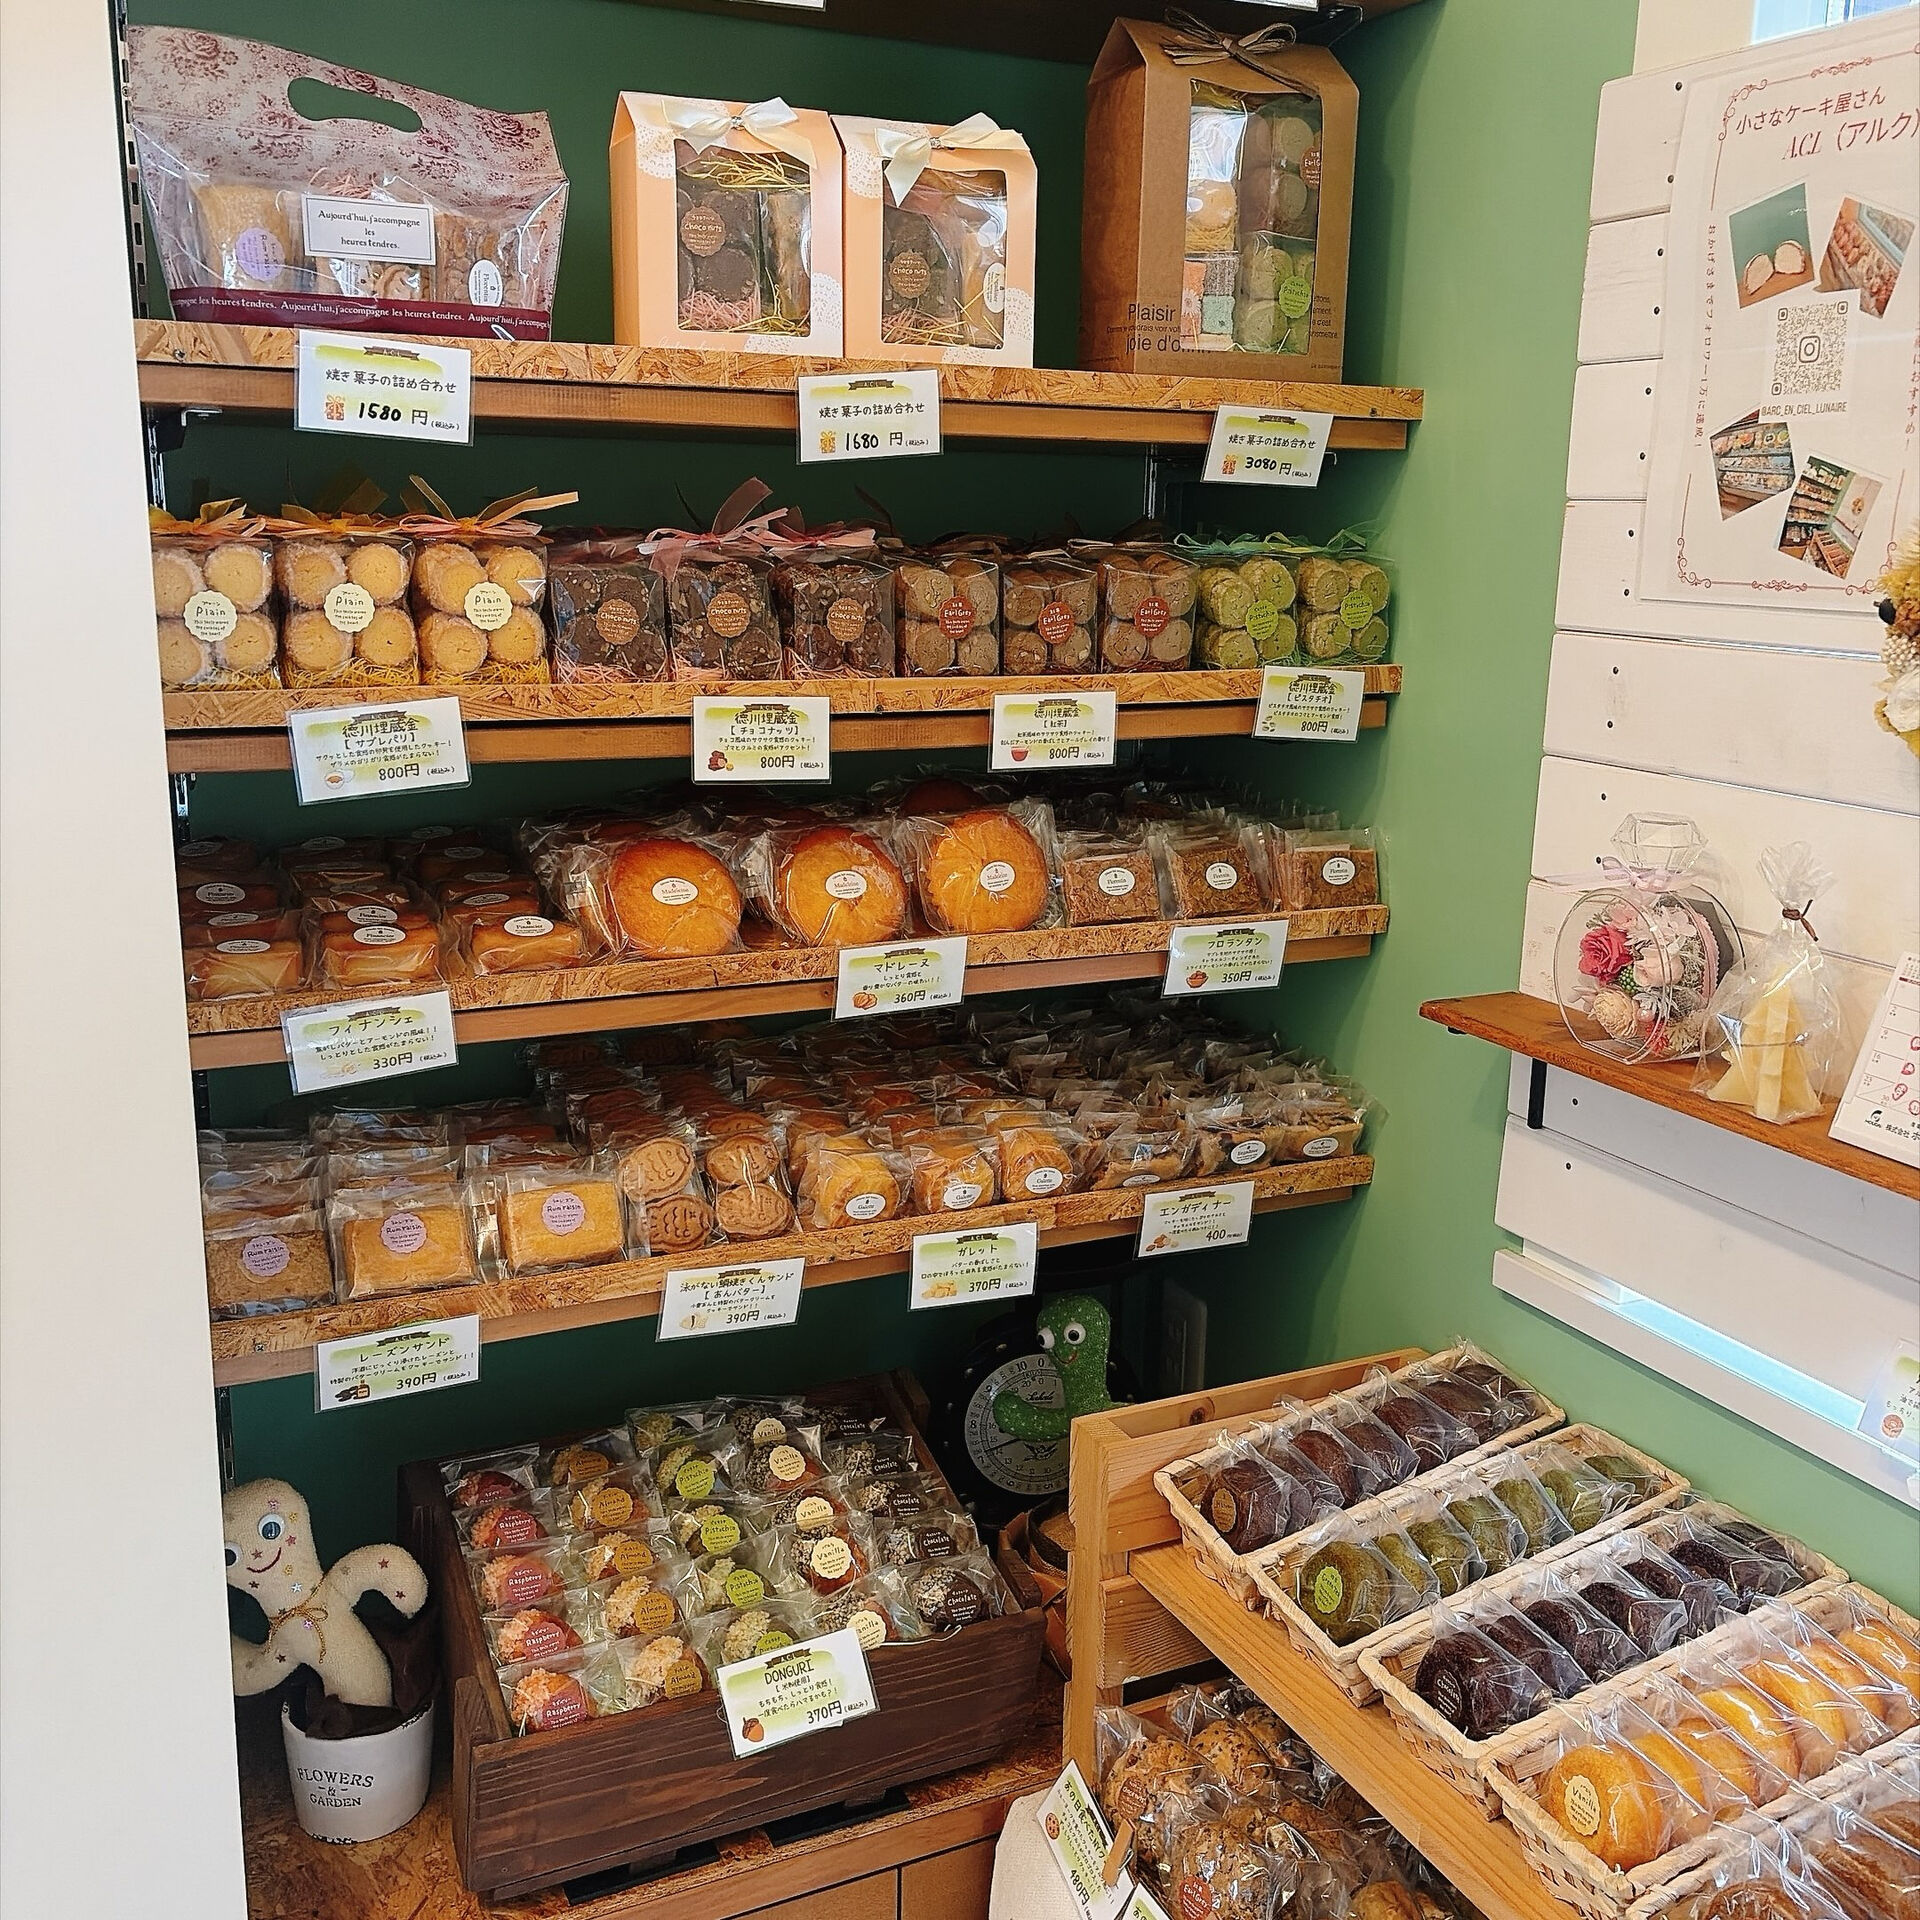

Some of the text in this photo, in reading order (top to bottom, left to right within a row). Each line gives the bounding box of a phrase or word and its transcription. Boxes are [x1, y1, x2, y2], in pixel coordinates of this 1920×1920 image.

[1736, 86, 1886, 135] 小さなケーキ屋さん
[364, 228, 375, 237] les
[199, 297, 211, 305] les
[392, 308, 403, 317] les
[1128, 303, 1176, 321] Plaisir
[1125, 333, 1152, 355] joie
[325, 368, 457, 394] 焼き菓子の詰め合わせ
[818, 402, 925, 418] 焼き菓子の詰め合わせ
[1228, 433, 1316, 449] 焼き菓子の詰め合わせ
[335, 596, 364, 606] Plain
[474, 595, 502, 605] Plain
[197, 606, 226, 617] Plain
[1289, 682, 1337, 695] 徳川埋蔵金
[735, 711, 800, 725] 徳川埋蔵金
[1034, 707, 1081, 719] 徳川埋蔵金
[342, 718, 420, 738] 徳川埋蔵金
[1301, 721, 1328, 732] 800円
[1049, 746, 1080, 760] 800円
[760, 755, 795, 768] 800円
[378, 762, 419, 781] 800円
[1208, 937, 1263, 949] フロランタン
[874, 958, 930, 973] マドレーヌ
[1221, 970, 1252, 983] 350円
[894, 990, 926, 1004] 360円
[328, 1016, 414, 1036] フィナンシェ
[373, 1052, 413, 1070] 330円
[1885, 1123, 1909, 1139] 株式会社
[546, 1204, 560, 1212] Rum
[1159, 1200, 1231, 1217] エンガディナー
[386, 1224, 422, 1234] Rum raisin
[1206, 1229, 1226, 1242] 400
[247, 1245, 285, 1258] Rum raisin
[957, 1244, 998, 1257] ガレット
[969, 1278, 1001, 1293] 370円
[725, 1310, 760, 1324] 390円
[360, 1337, 451, 1362] レーズンサンド
[396, 1372, 437, 1390] 390円
[758, 1428, 784, 1438] Vanilla
[774, 1453, 798, 1465] Vanilla
[800, 1505, 827, 1519] Vanilla
[816, 1547, 845, 1560] Vanilla
[509, 1574, 542, 1586] Raspberry
[947, 1594, 977, 1606] Chocolate
[640, 1604, 668, 1615] Almond
[525, 1631, 560, 1647] Raspberry
[671, 1673, 696, 1684] Almond
[764, 1660, 814, 1685] DONGURI
[546, 1702, 581, 1717] Raspberry
[806, 1700, 842, 1724] 370円
[297, 1767, 374, 1788] FLOWERS
[309, 1793, 362, 1808] GARDEN
[1573, 1786, 1596, 1812] Vanilla
[1070, 1869, 1091, 1905] 480円
